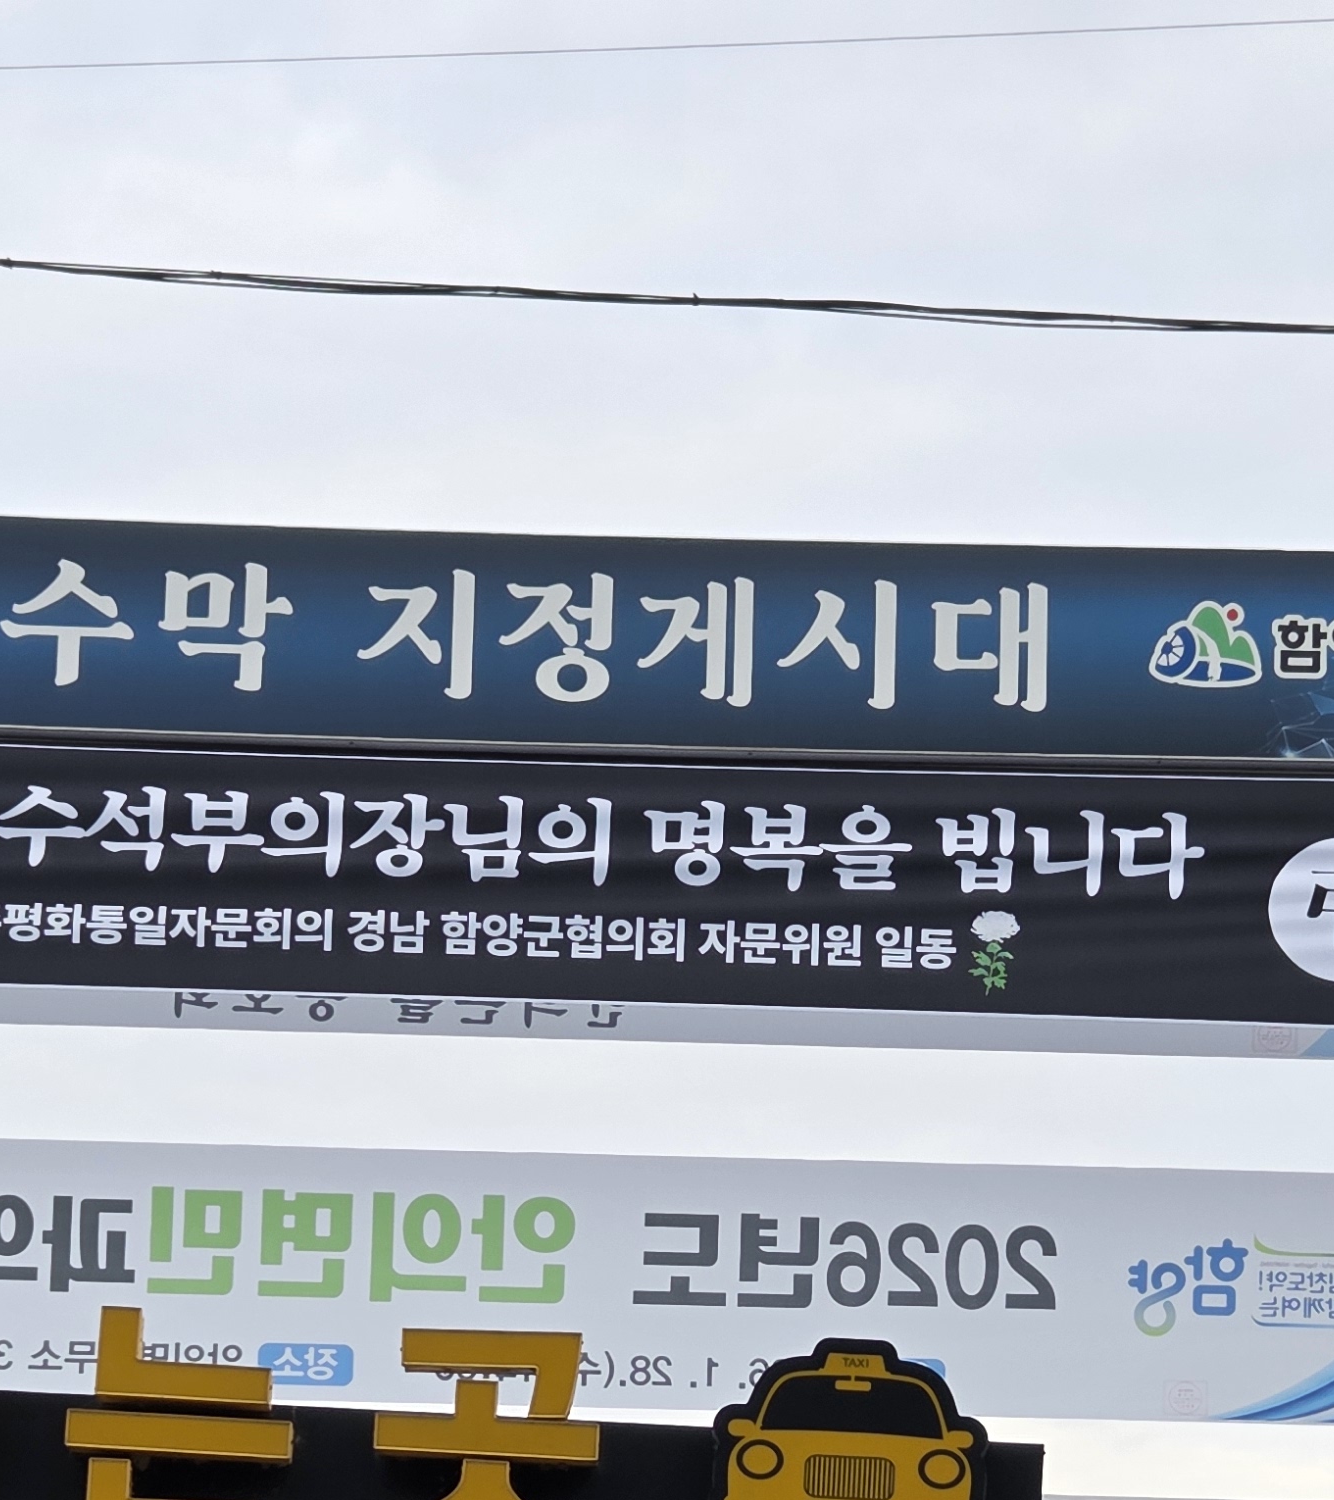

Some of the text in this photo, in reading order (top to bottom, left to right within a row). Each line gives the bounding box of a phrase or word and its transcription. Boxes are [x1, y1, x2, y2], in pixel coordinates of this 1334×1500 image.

[357, 568, 1049, 713] 지정게시대
[643, 798, 913, 894] 명복을
[934, 806, 1205, 901] 빕니다
[346, 908, 430, 955] 경남
[442, 910, 686, 963] 함양군협의회
[698, 918, 862, 967] 자문위원
[875, 925, 958, 971] 일동
[842, 1357, 870, 1368] TAXI
